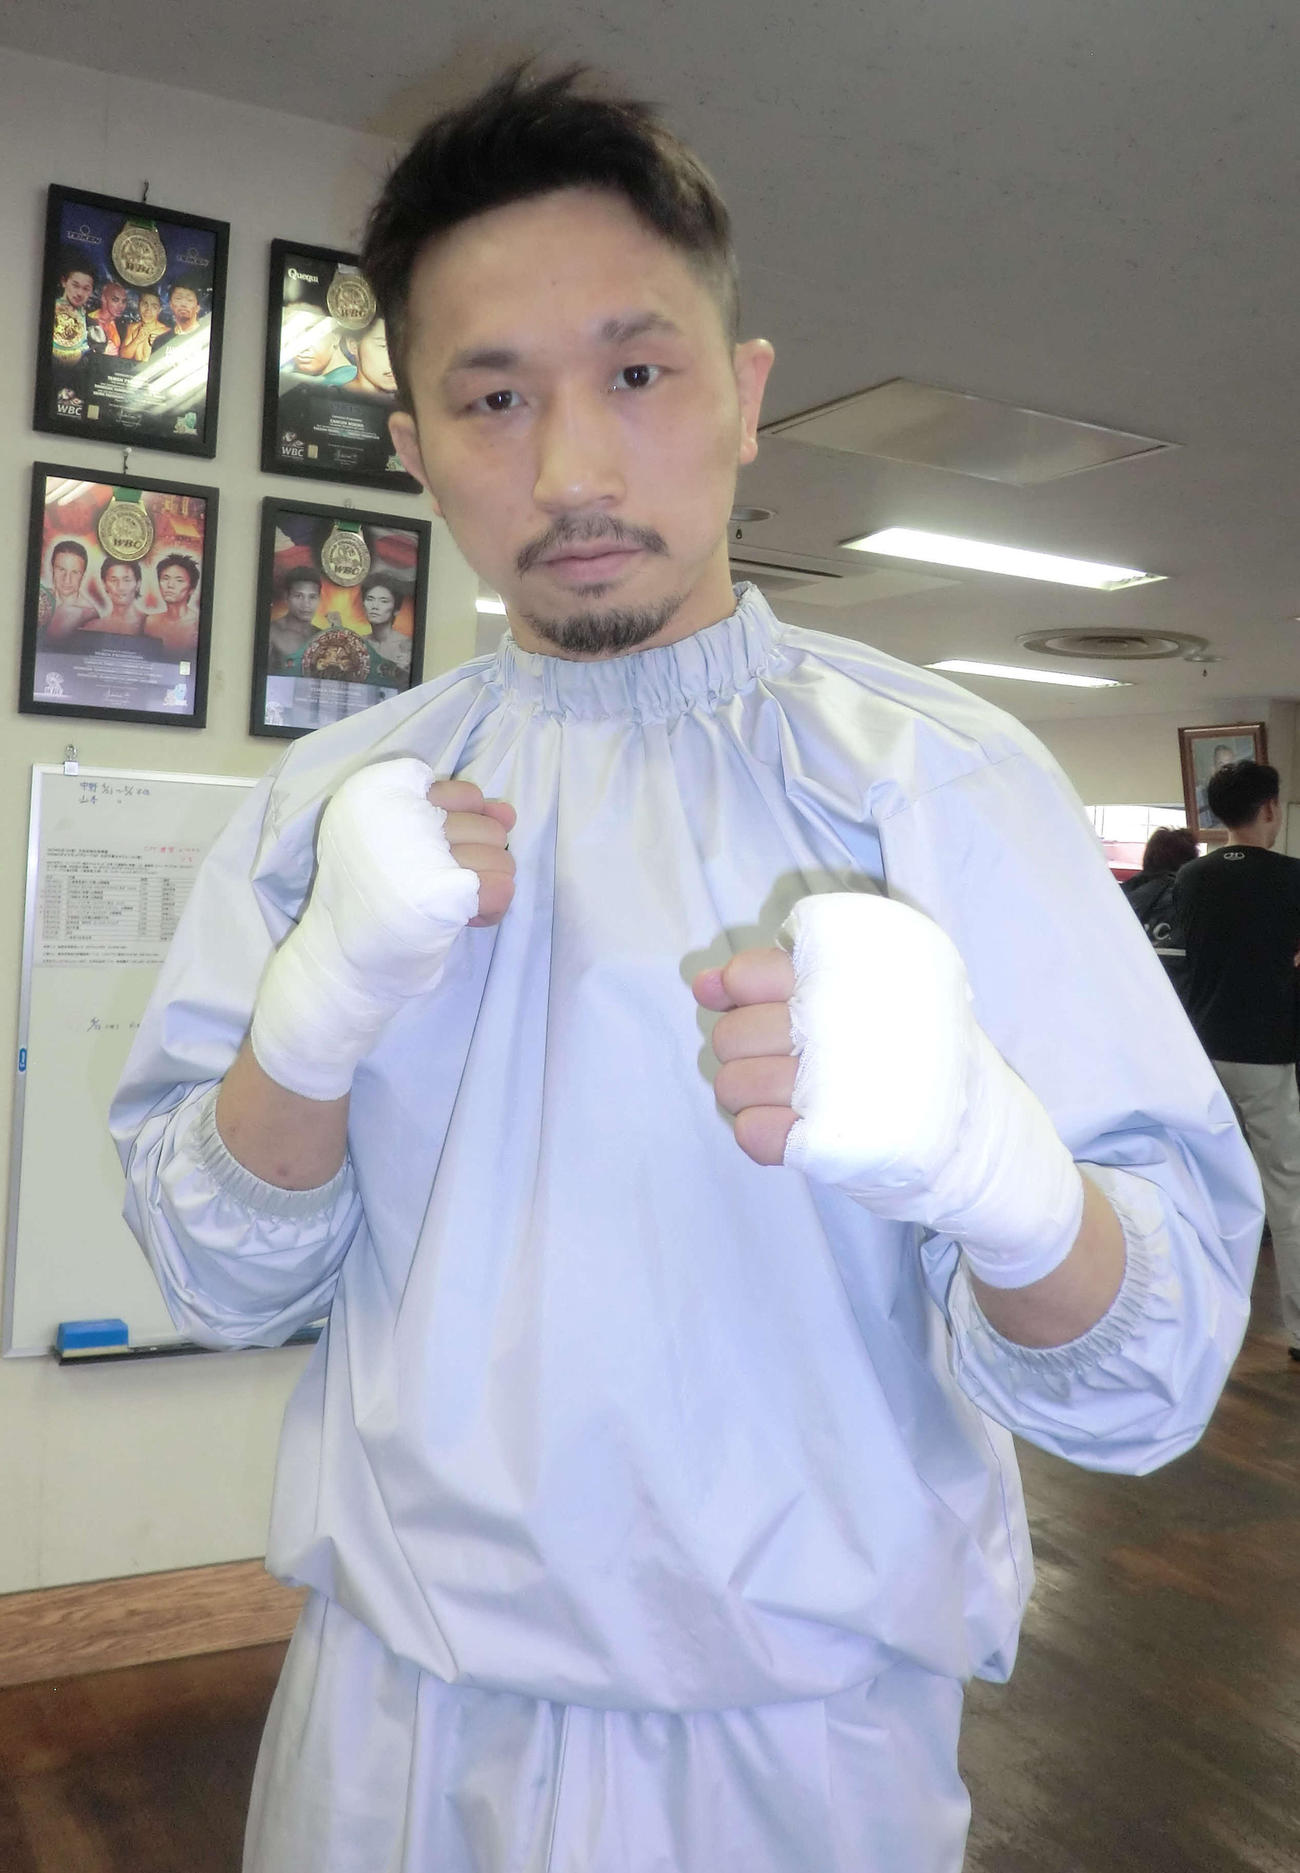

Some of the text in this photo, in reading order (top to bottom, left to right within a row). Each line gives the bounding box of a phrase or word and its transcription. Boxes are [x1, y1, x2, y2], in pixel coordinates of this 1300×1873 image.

[56, 404, 83, 416] WBC
[281, 446, 305, 457] WBC
[334, 564, 361, 576] WBC
